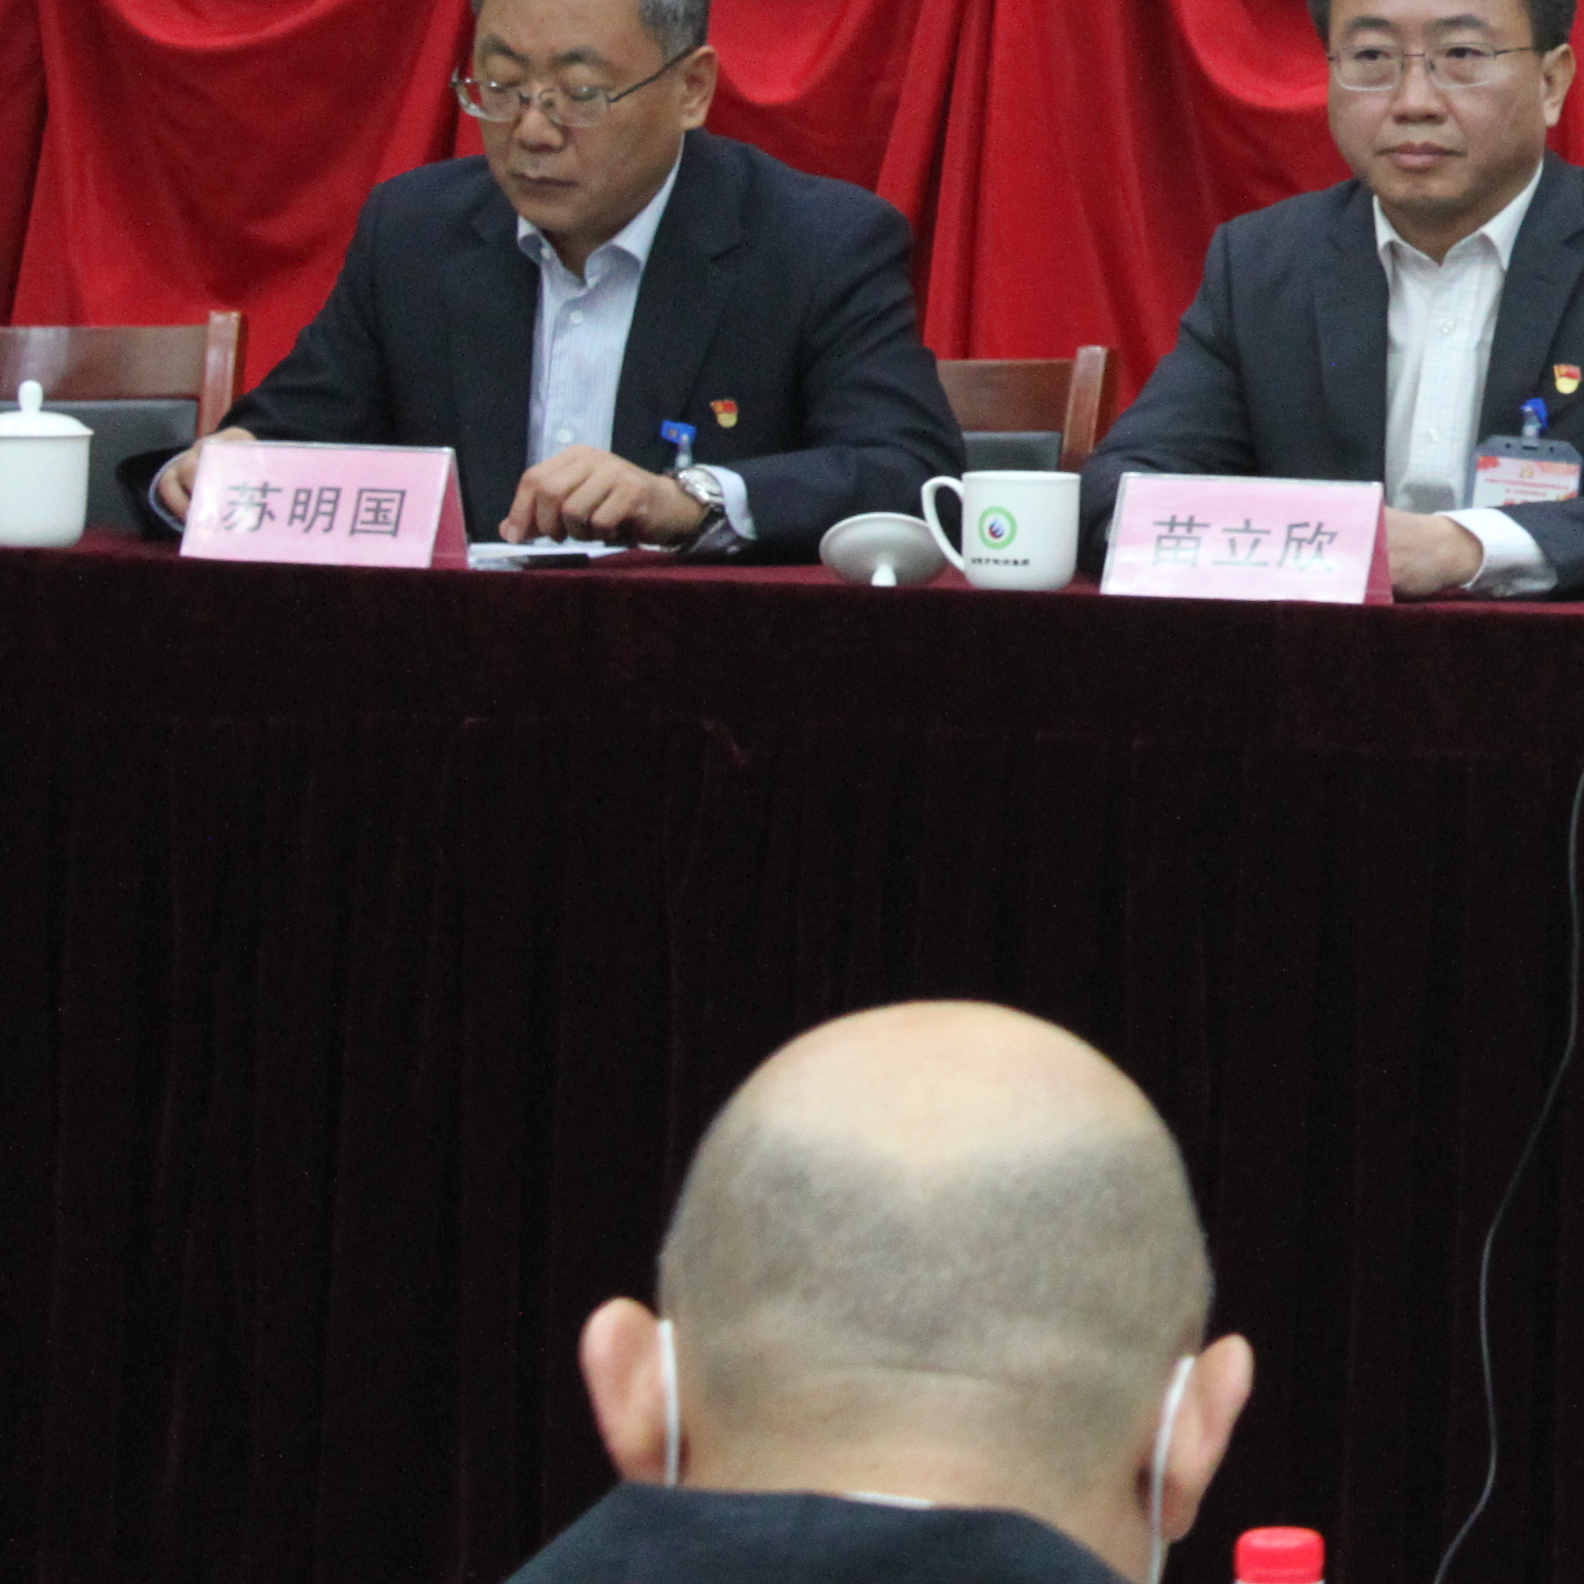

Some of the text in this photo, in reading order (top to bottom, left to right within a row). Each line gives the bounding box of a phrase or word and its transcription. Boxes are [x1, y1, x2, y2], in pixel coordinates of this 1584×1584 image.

[222, 481, 407, 538] 苏明国
[1152, 514, 1339, 572] 苗立欣
